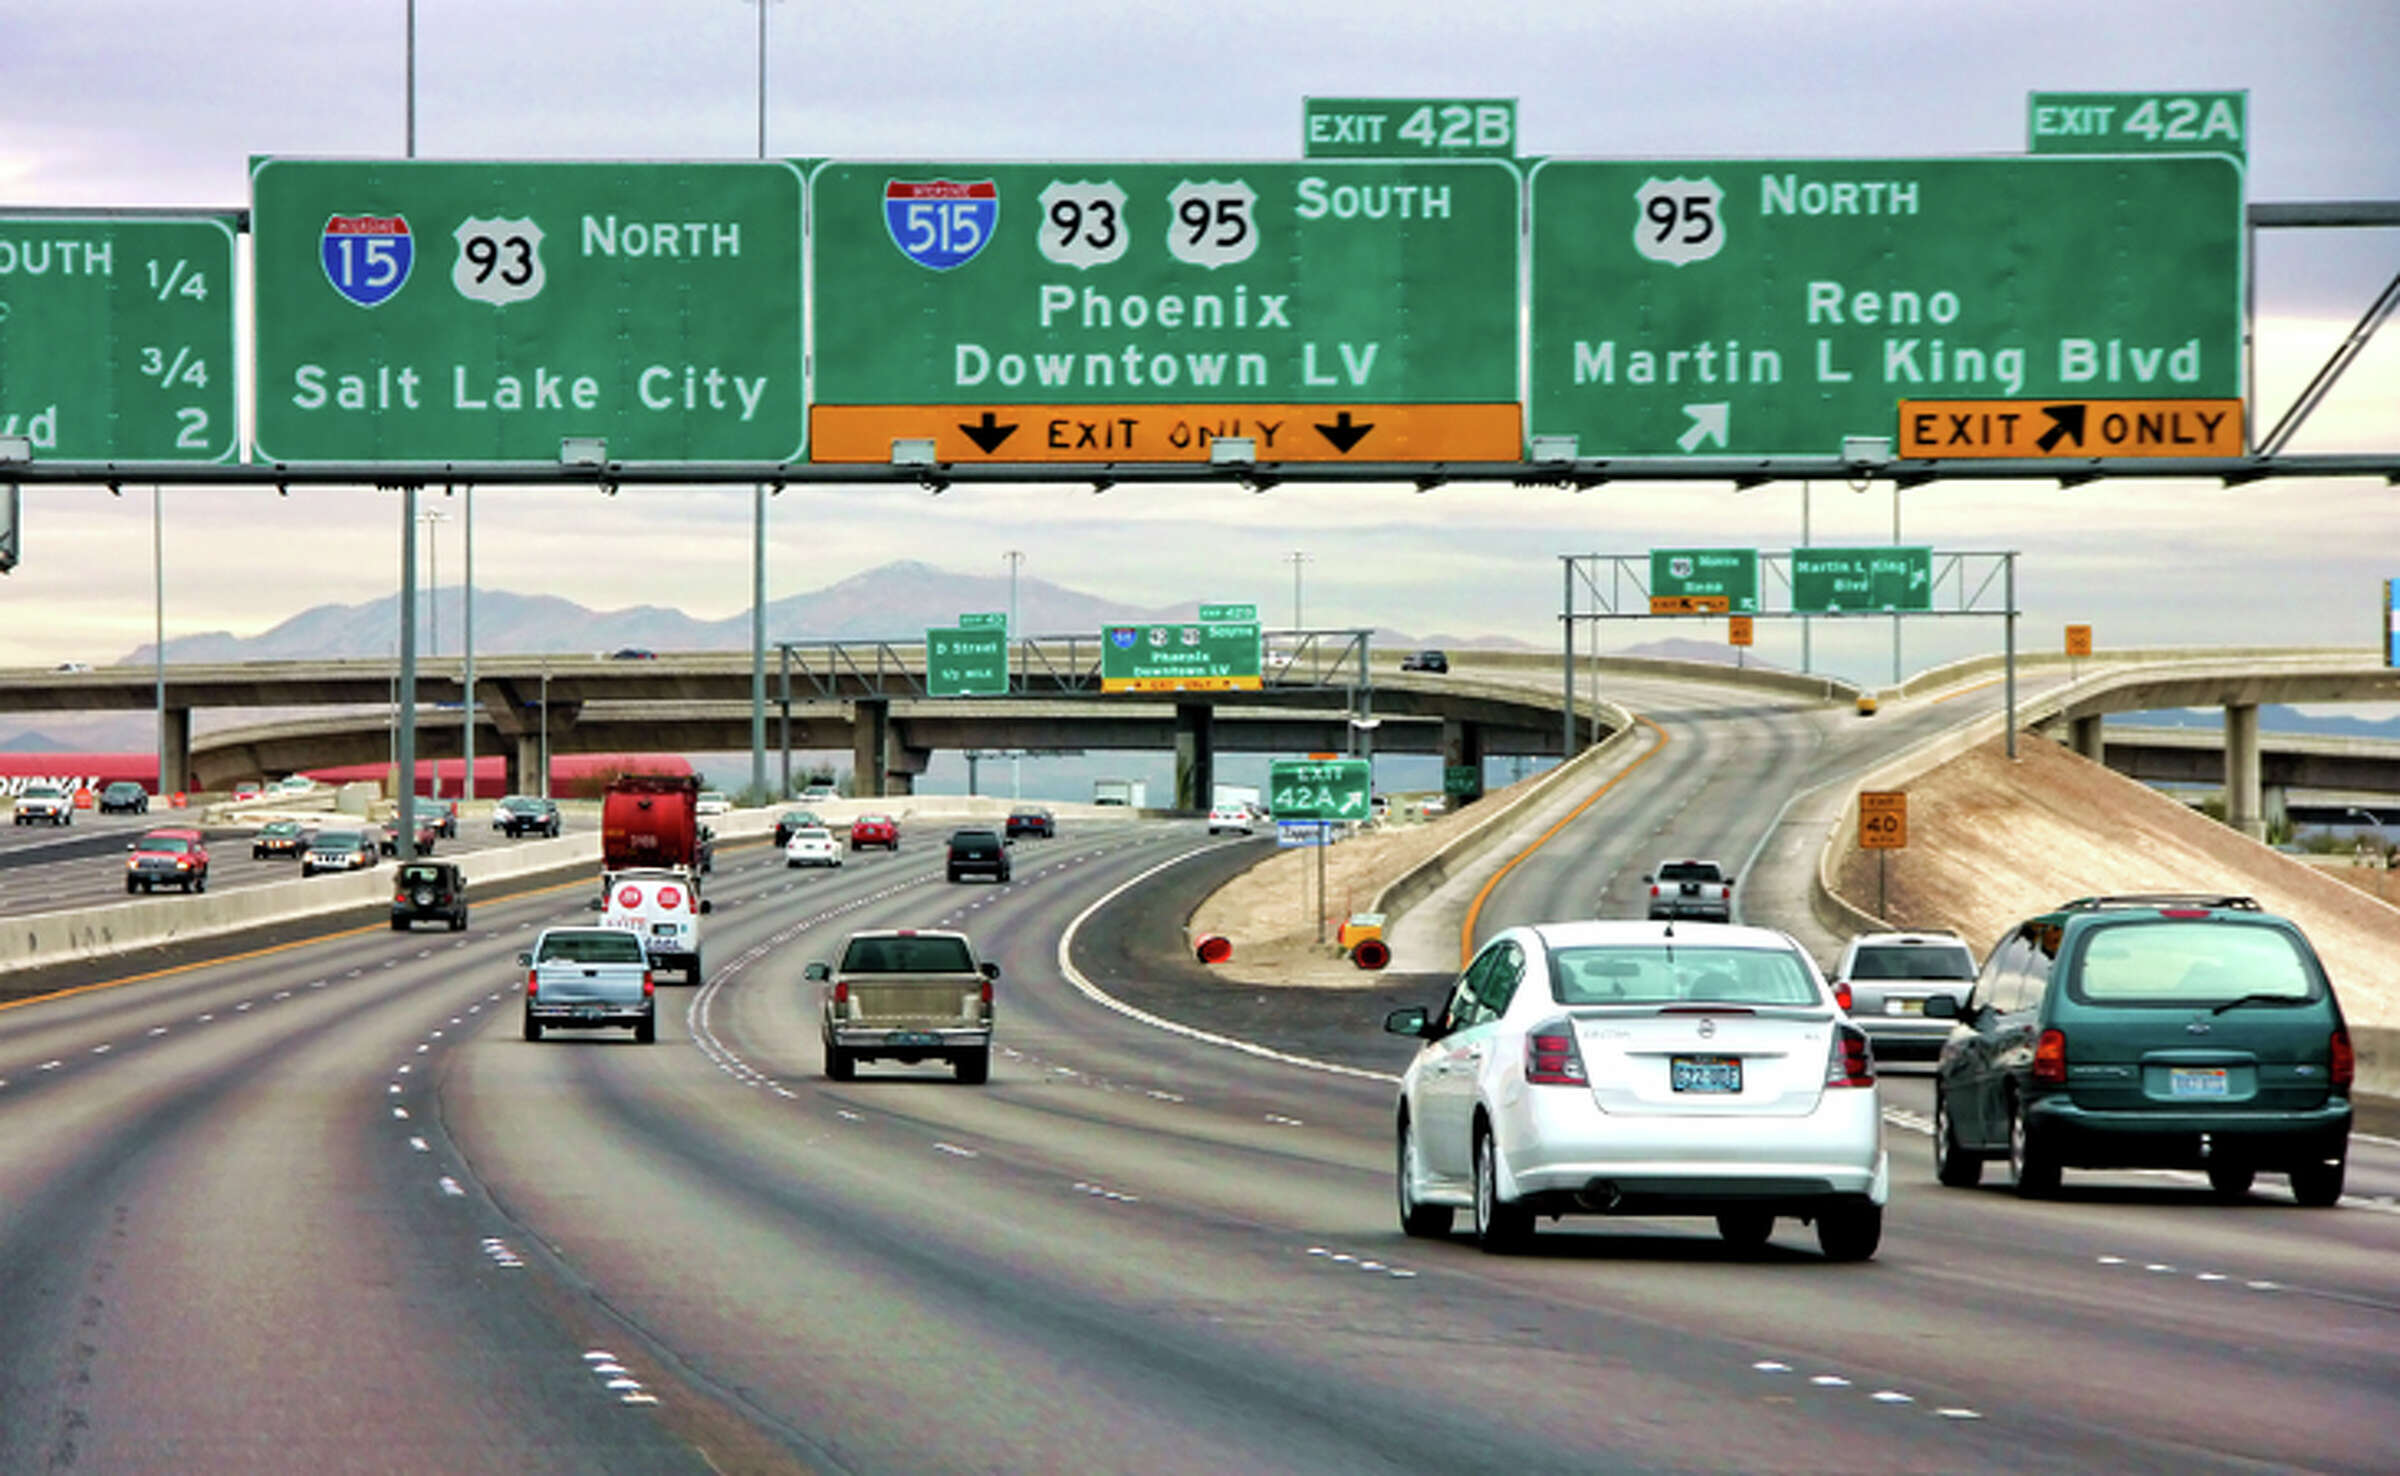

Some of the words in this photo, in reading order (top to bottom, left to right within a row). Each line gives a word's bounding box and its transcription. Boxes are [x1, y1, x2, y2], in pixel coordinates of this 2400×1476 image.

[1310, 114, 1388, 145] EXIT
[1397, 106, 1512, 148] 42B
[2035, 107, 2115, 138] EXIT
[2123, 99, 2239, 142] 42A
[908, 204, 981, 253] 515
[1051, 200, 1116, 249] 93
[1180, 199, 1246, 246] 95
[1296, 177, 1449, 219] SOUTH
[1647, 196, 1713, 244] 95
[1762, 175, 1917, 214] NORTH
[338, 239, 398, 287] 15
[466, 236, 533, 285] 93
[583, 216, 739, 256] NORTH
[147, 260, 207, 300] 1/4
[1041, 285, 1290, 327] Phoenix
[1808, 282, 1958, 323] Reno
[142, 347, 208, 388] 3/4
[956, 344, 1266, 386] Downtown
[1304, 343, 1378, 385] LV
[1575, 341, 1780, 384] Martin
[1818, 340, 1851, 381] L
[1885, 340, 2023, 394] King
[2061, 339, 2198, 381] Blvd
[293, 365, 419, 408] Salt
[455, 366, 598, 409] Lake
[639, 366, 767, 420] City
[176, 407, 209, 448] 2
[1048, 419, 1138, 448] EXIT
[1915, 414, 2020, 445] EXIT
[2103, 413, 2224, 444] ONLY
[1298, 766, 1343, 781] EXIT
[1275, 785, 1336, 809] 42A
[1867, 815, 1898, 833] 40
